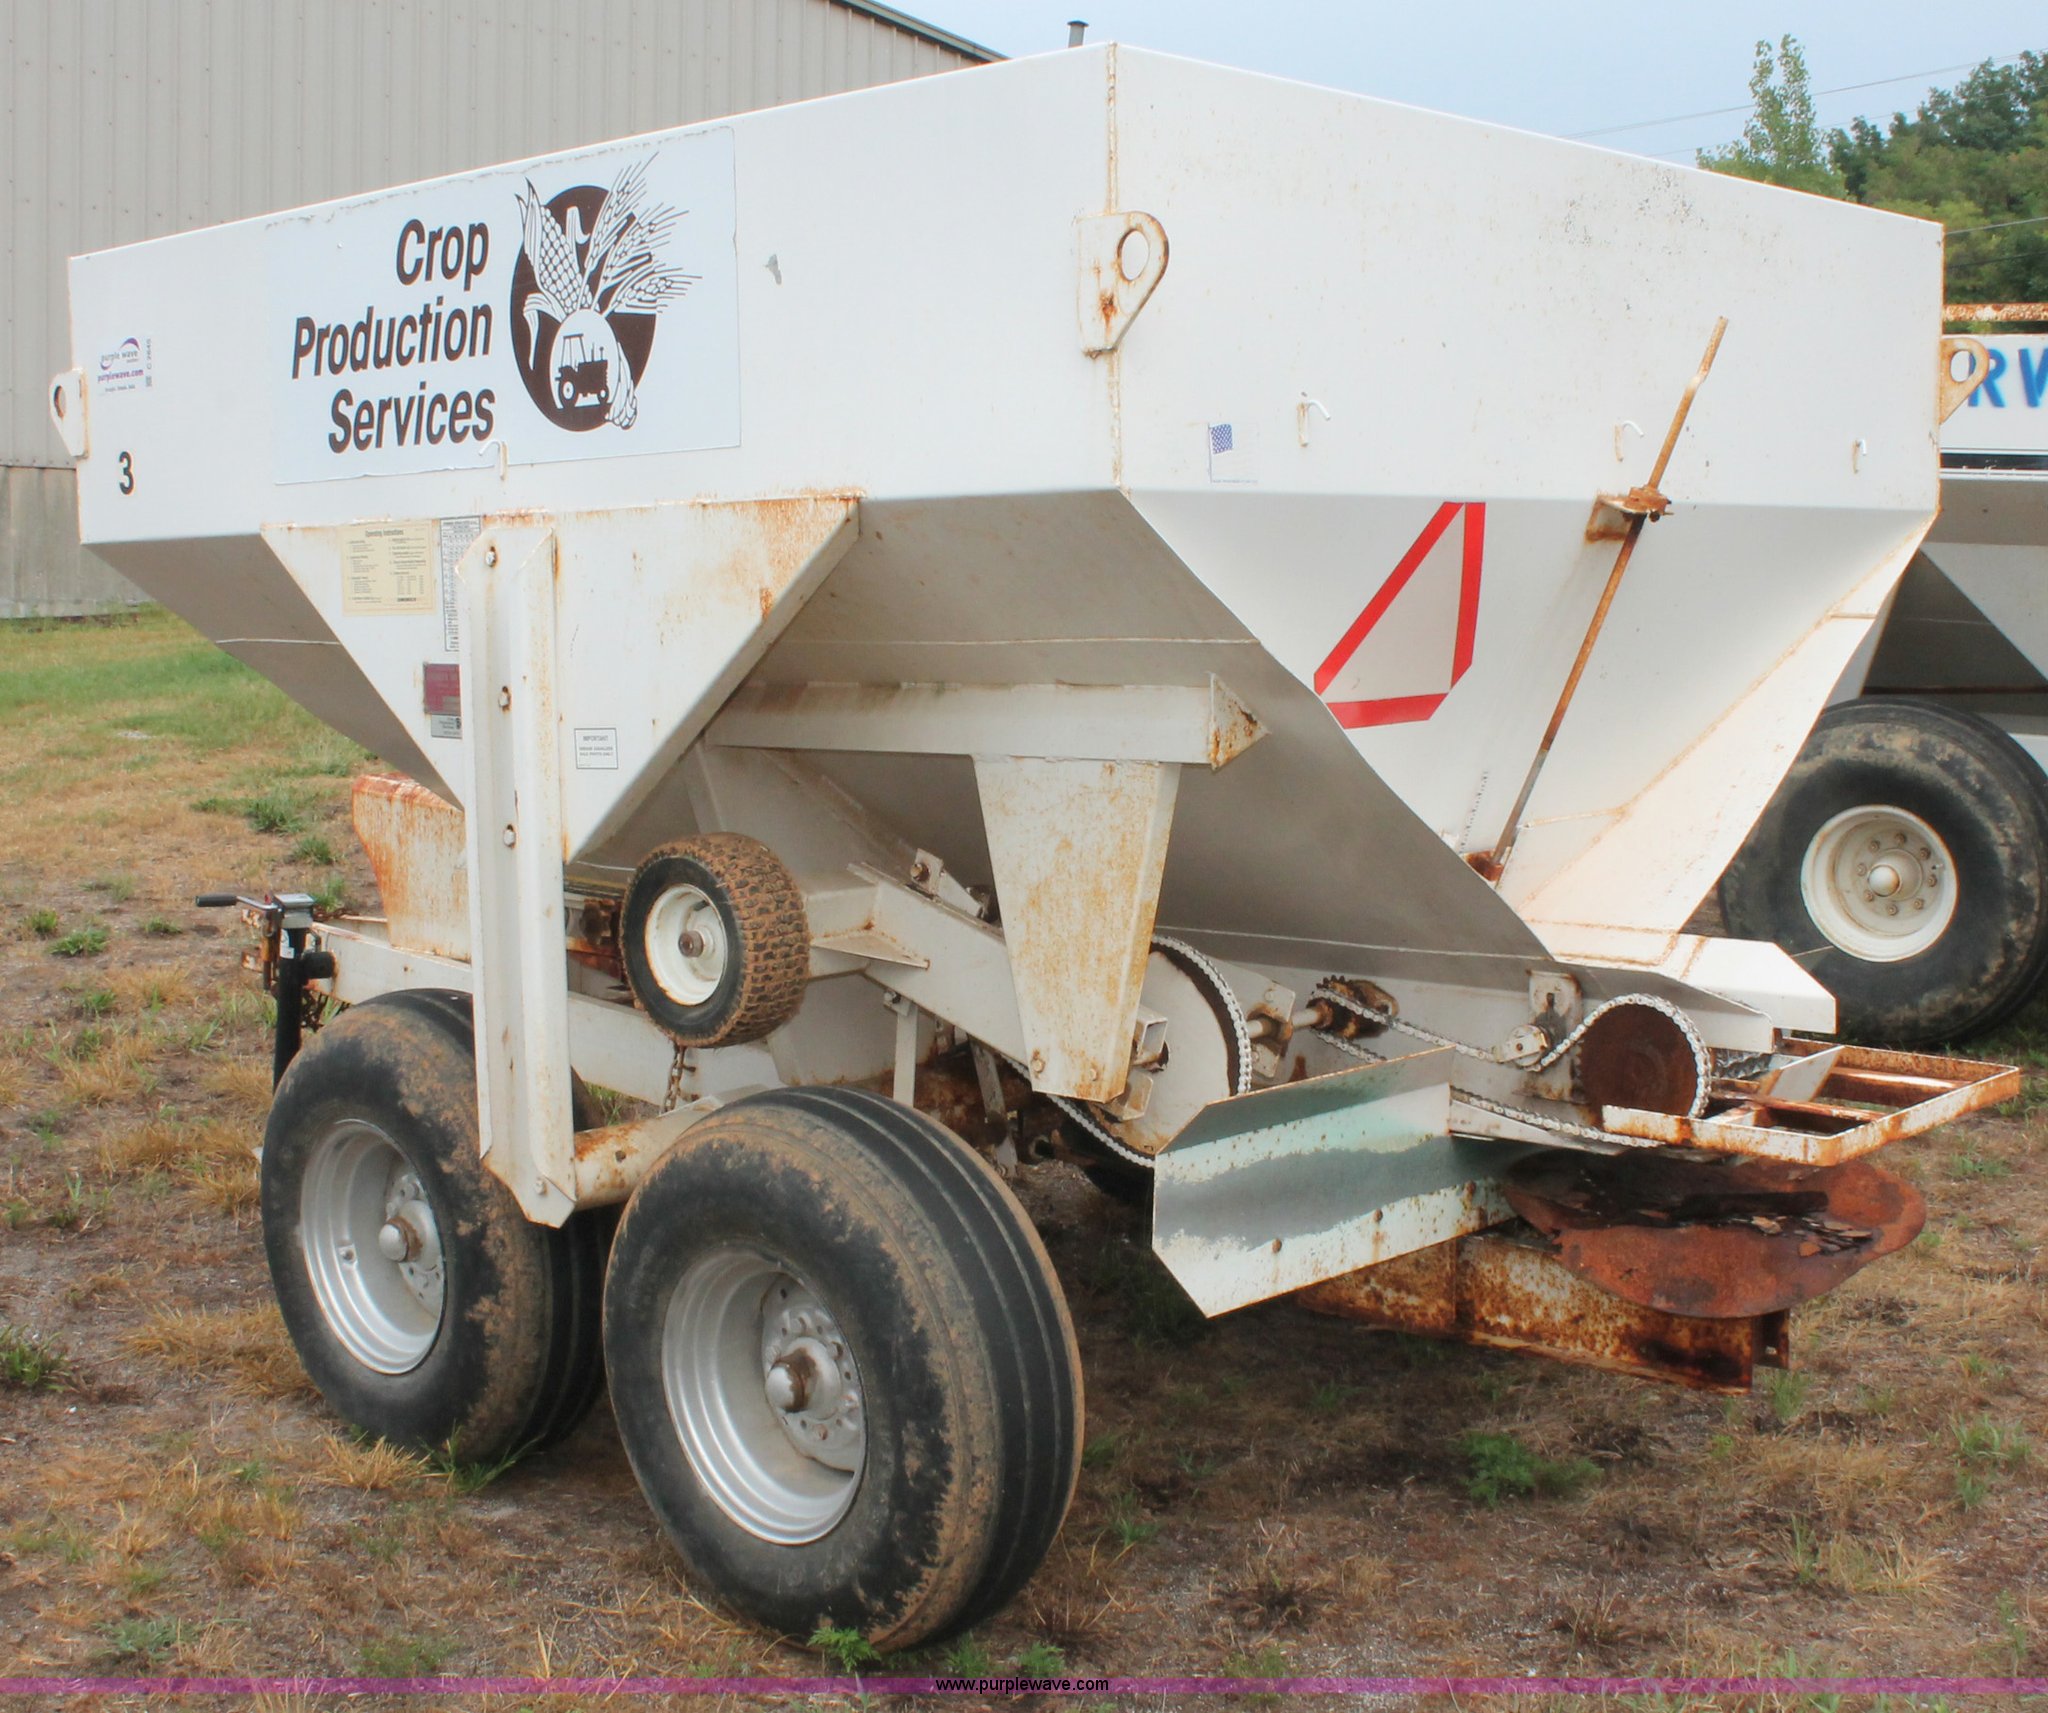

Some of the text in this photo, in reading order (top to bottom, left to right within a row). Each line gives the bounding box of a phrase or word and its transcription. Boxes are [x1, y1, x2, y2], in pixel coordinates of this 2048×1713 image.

[396, 218, 489, 292] Crop
[291, 295, 493, 379] Production
[97, 369, 144, 383] purplewave.com
[328, 381, 496, 454] Services
[119, 451, 134, 495] 3
